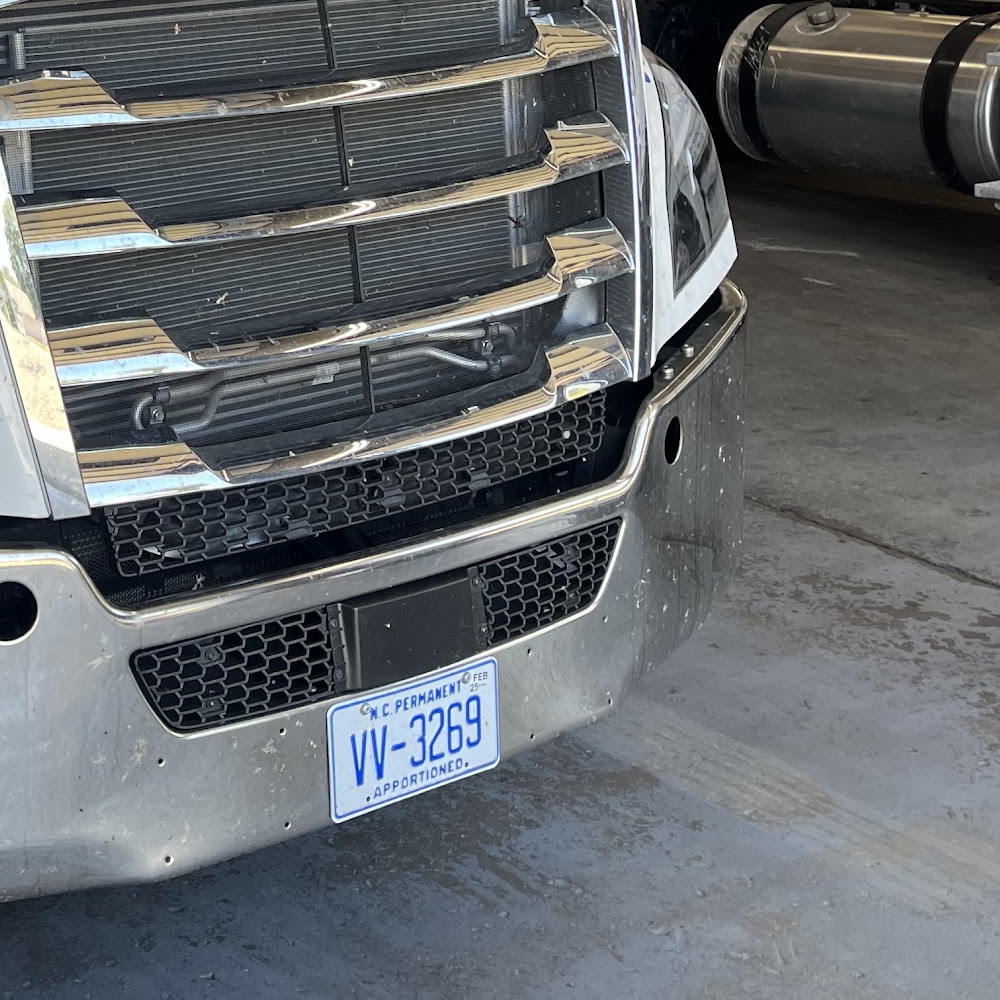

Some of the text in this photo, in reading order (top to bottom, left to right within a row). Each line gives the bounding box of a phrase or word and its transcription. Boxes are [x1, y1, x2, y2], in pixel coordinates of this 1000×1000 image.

[473, 671, 489, 682] FEB
[395, 679, 462, 714] PERMANENT
[350, 695, 482, 787] VV-3269
[373, 758, 463, 799] APPORTIONED
